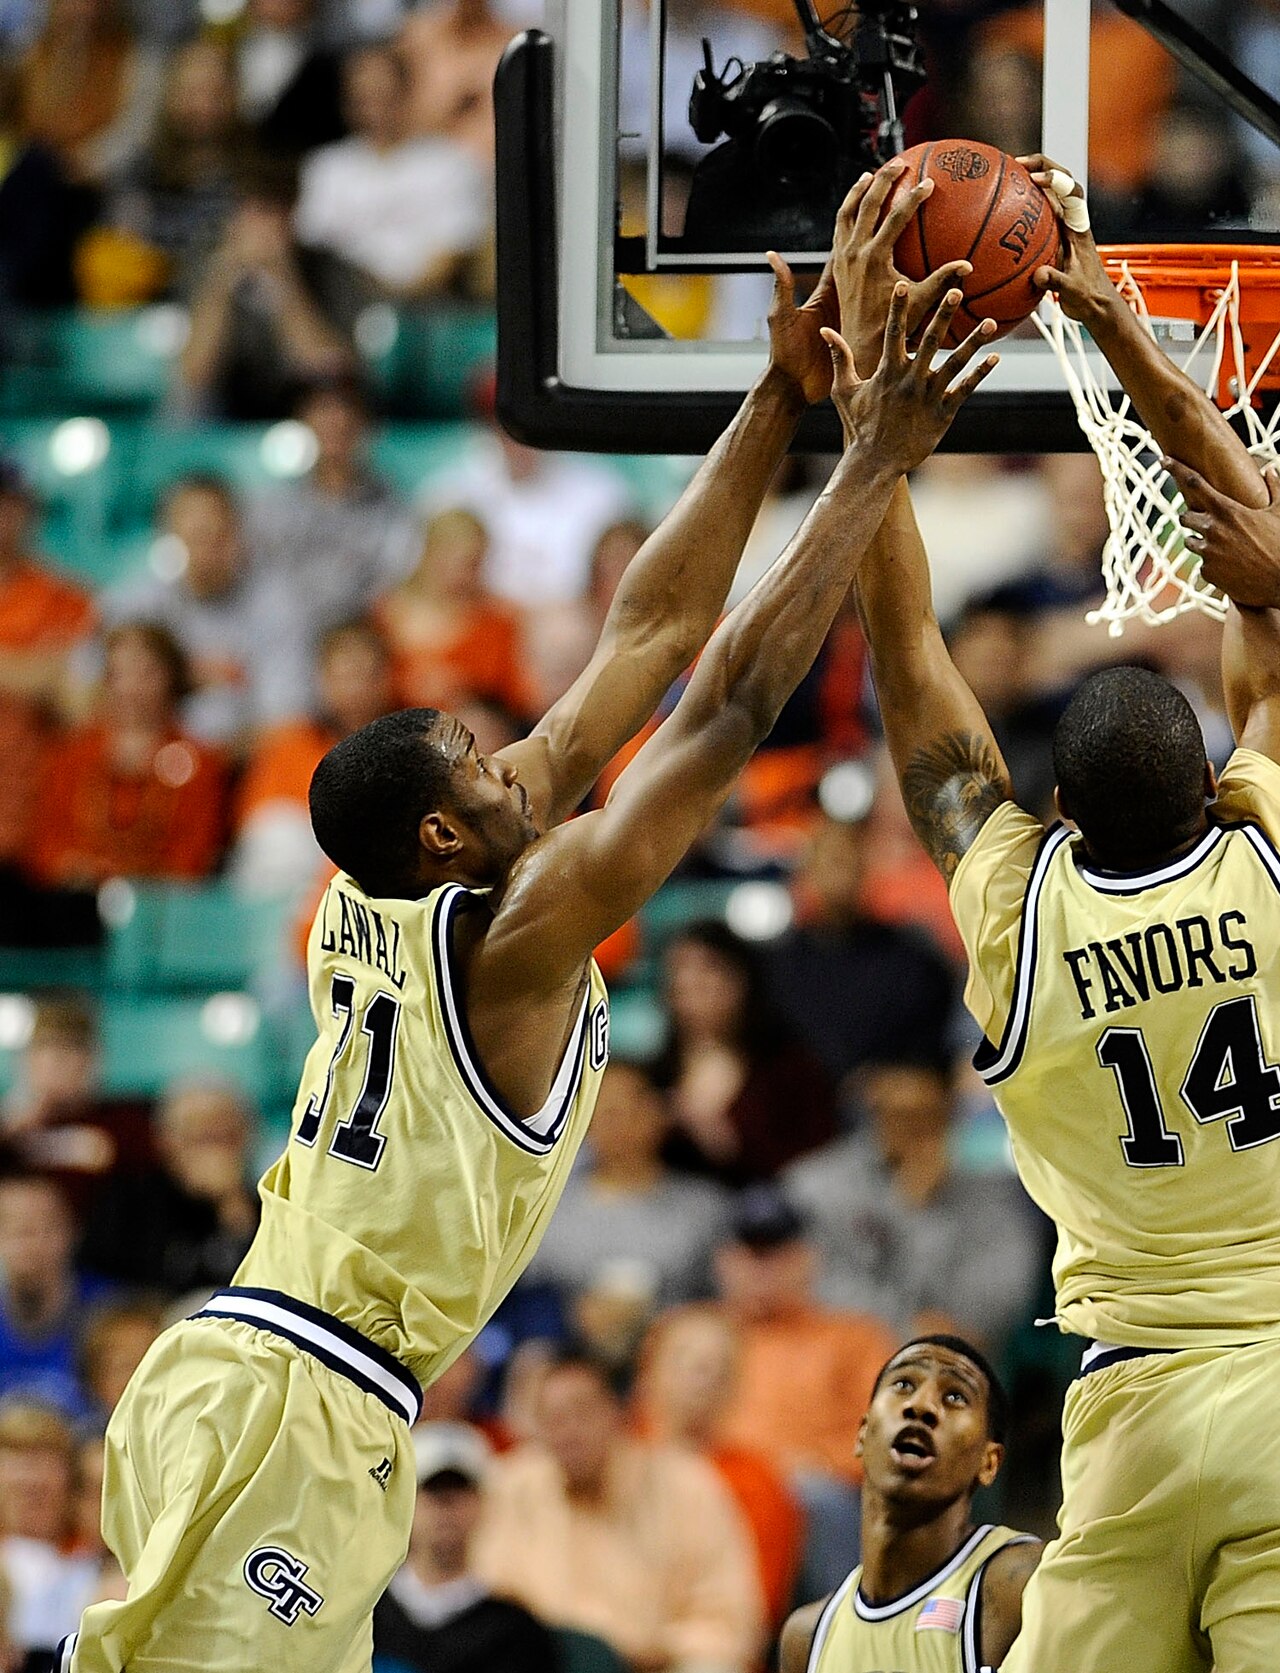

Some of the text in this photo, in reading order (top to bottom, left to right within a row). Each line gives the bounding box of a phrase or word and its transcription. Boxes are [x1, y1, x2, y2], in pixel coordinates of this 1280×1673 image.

[321, 885, 406, 990] LAWAL
[1063, 910, 1258, 1020] FAVORS
[295, 972, 401, 1173] 31
[244, 1546, 324, 1627] GT
